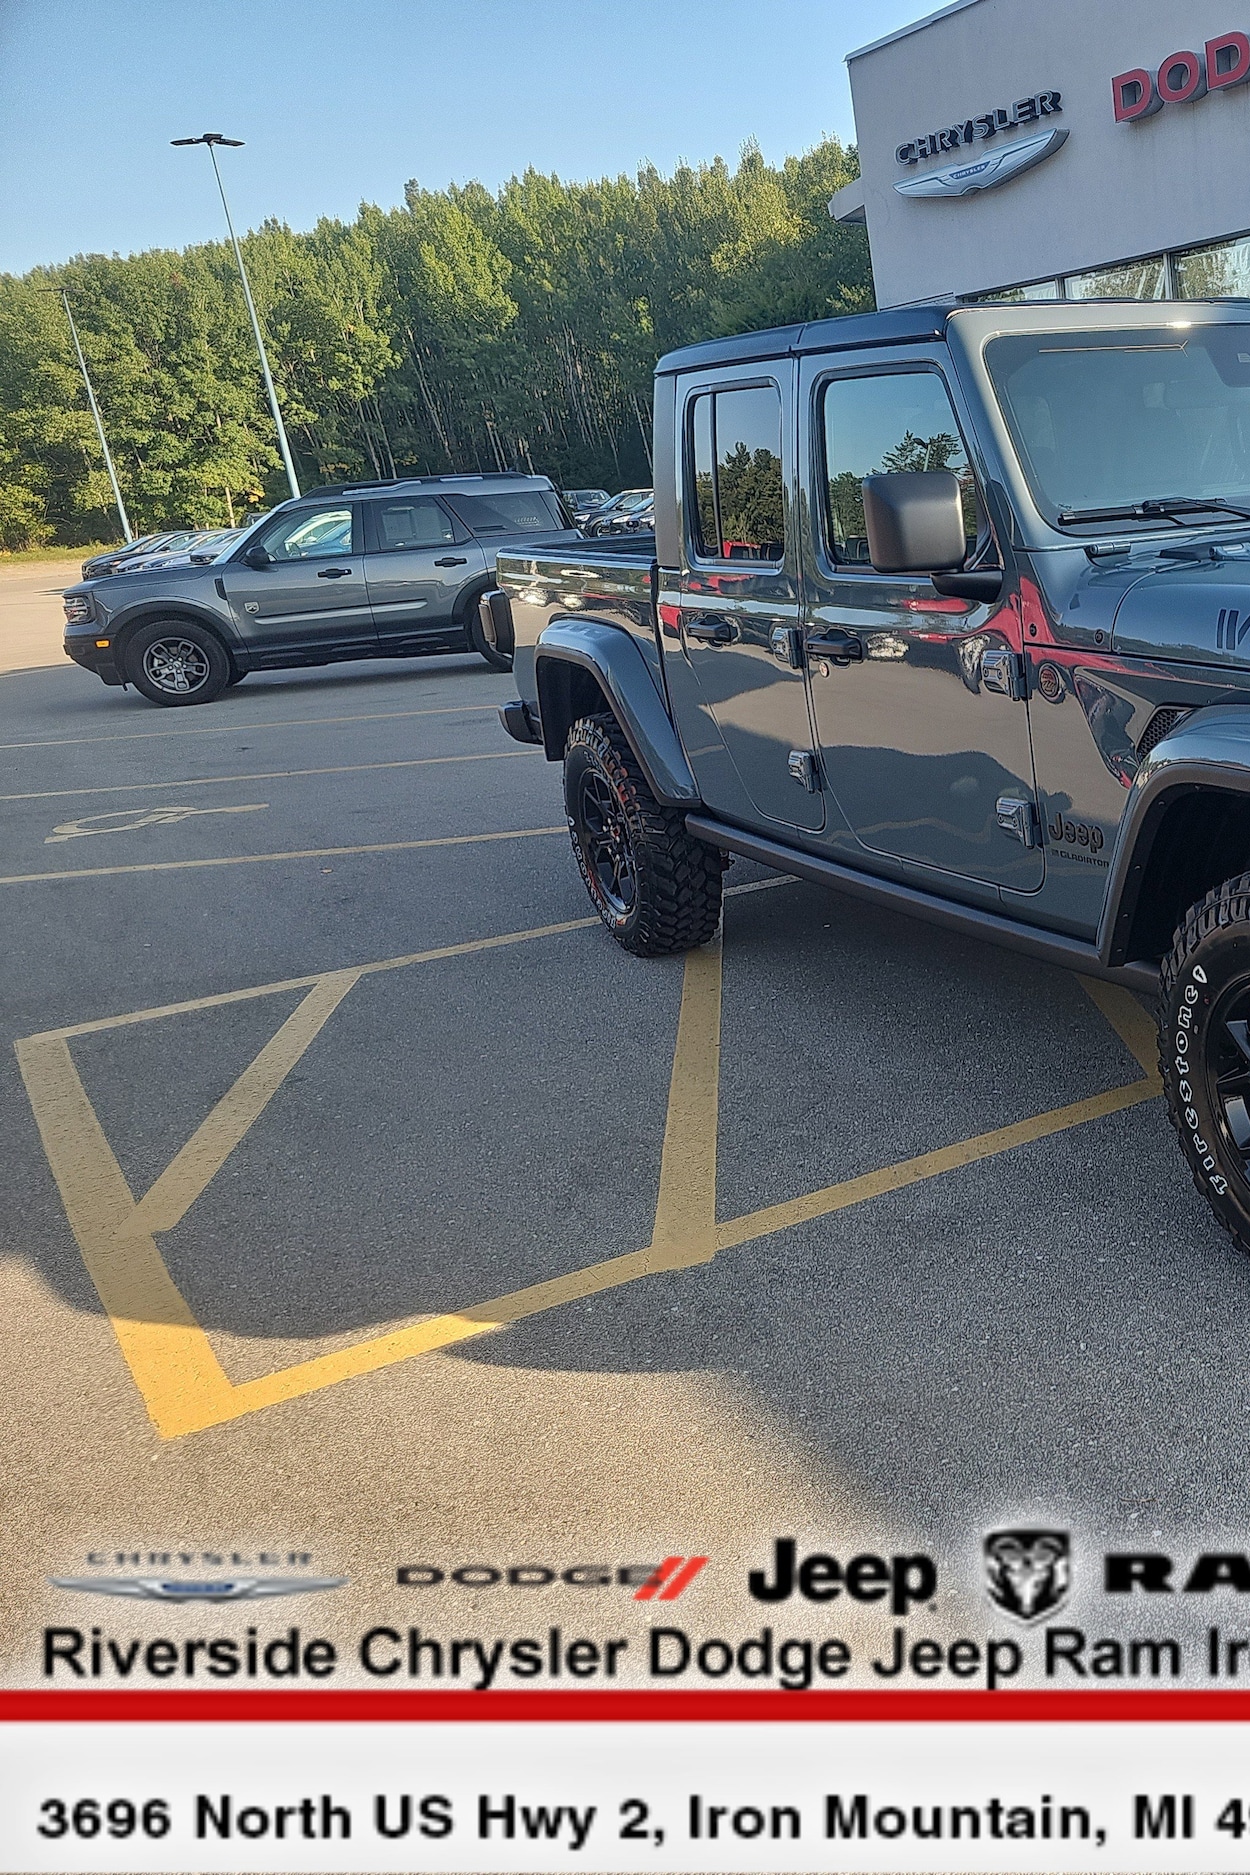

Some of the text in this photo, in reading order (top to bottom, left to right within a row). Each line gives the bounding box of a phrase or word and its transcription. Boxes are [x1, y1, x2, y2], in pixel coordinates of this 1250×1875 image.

[894, 90, 1063, 166] CHRYSLER
[952, 163, 986, 179] CHRYSLER
[1048, 811, 1105, 854] Jeep
[1060, 850, 1110, 868] GLADIATOR
